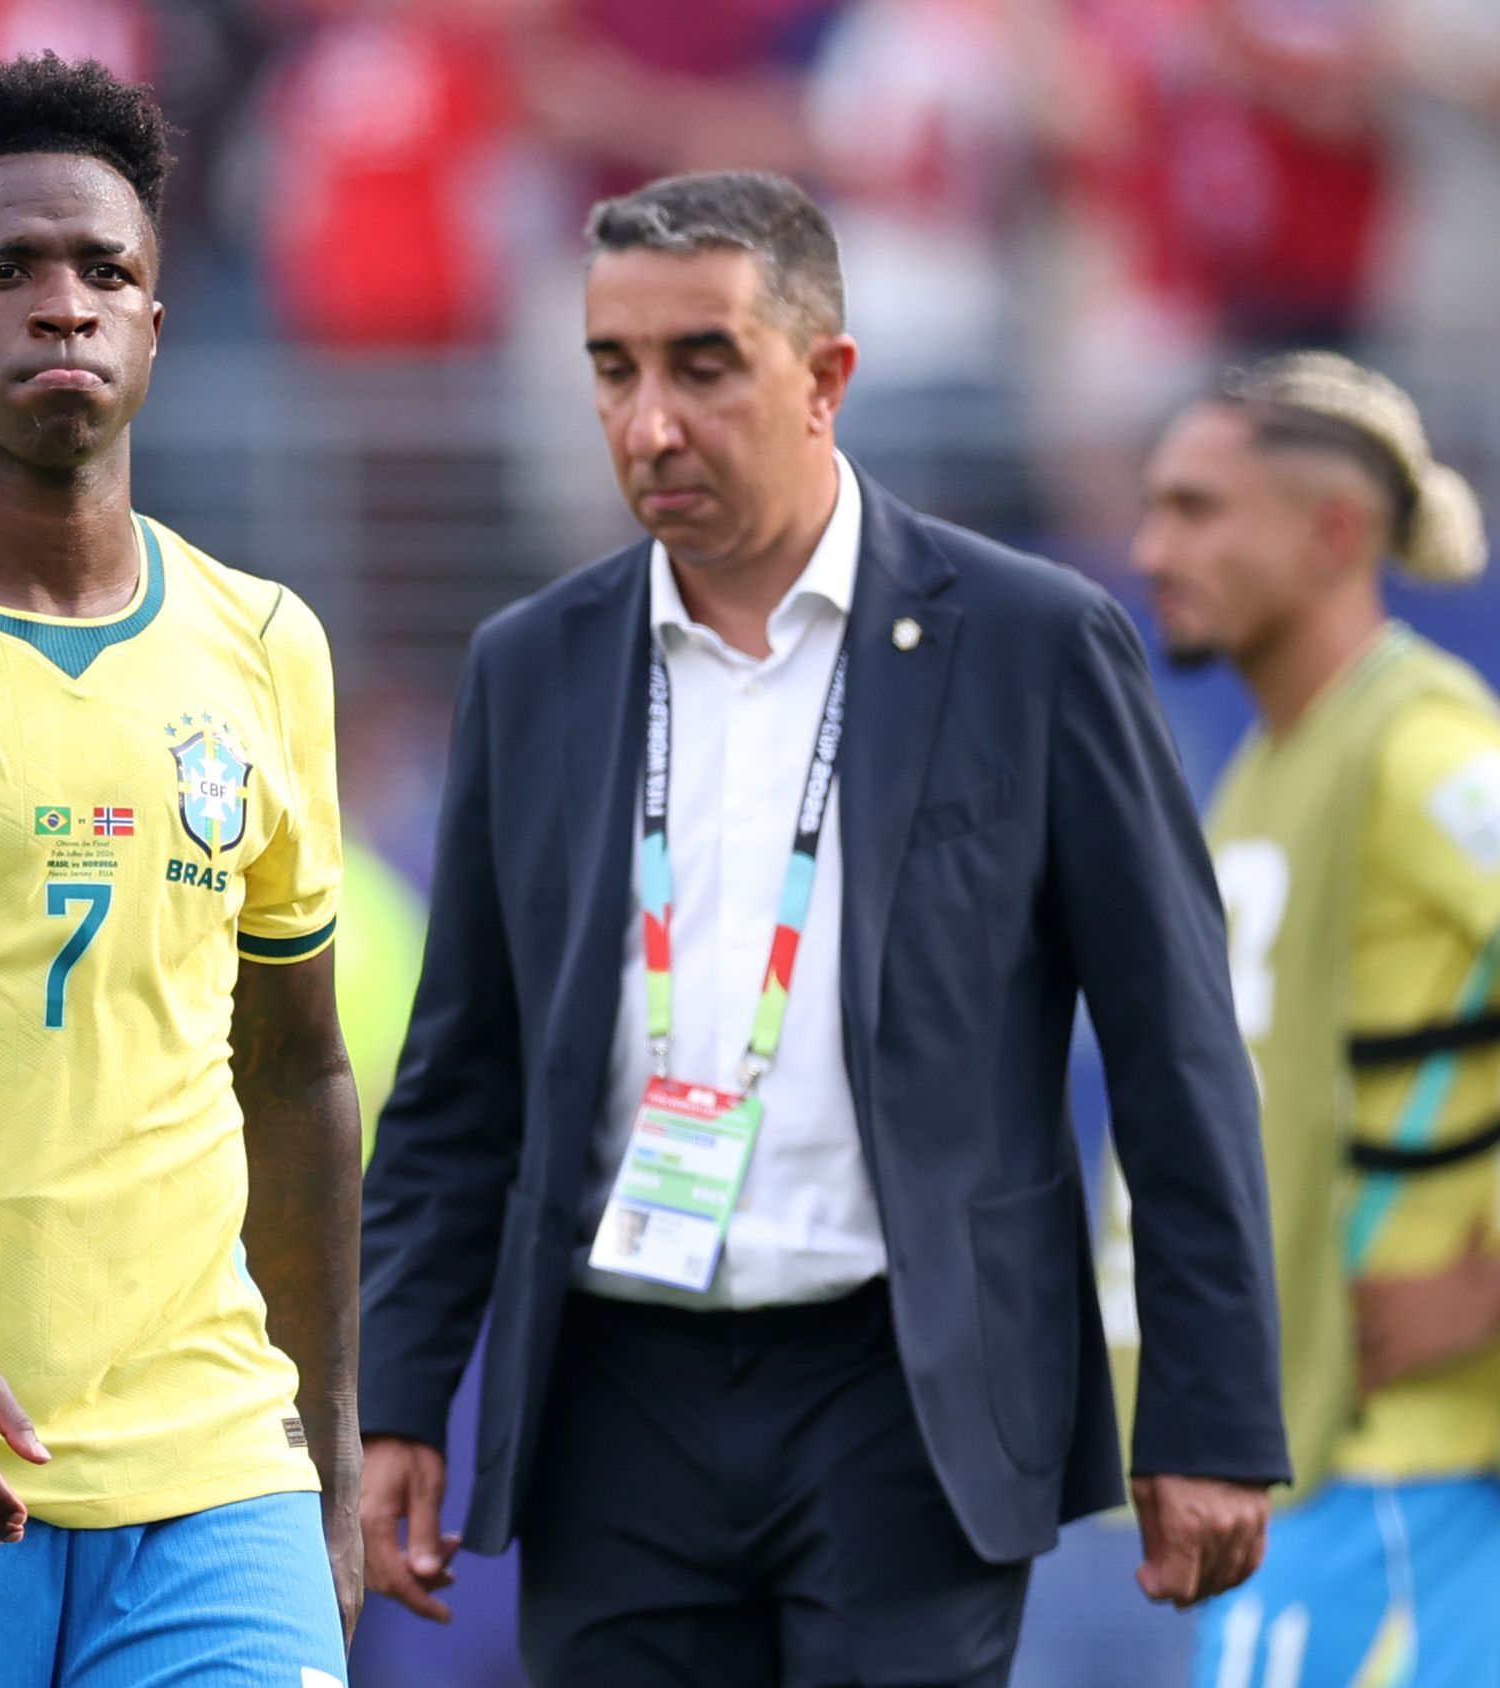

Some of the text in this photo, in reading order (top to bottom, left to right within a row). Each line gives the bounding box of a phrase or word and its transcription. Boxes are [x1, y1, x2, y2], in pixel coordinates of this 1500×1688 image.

[817, 722, 842, 762] CUP
[200, 780, 227, 798] CBF
[799, 760, 832, 836] 2026
[44, 882, 114, 1030] 7
[1214, 1590, 1311, 1688] 11
